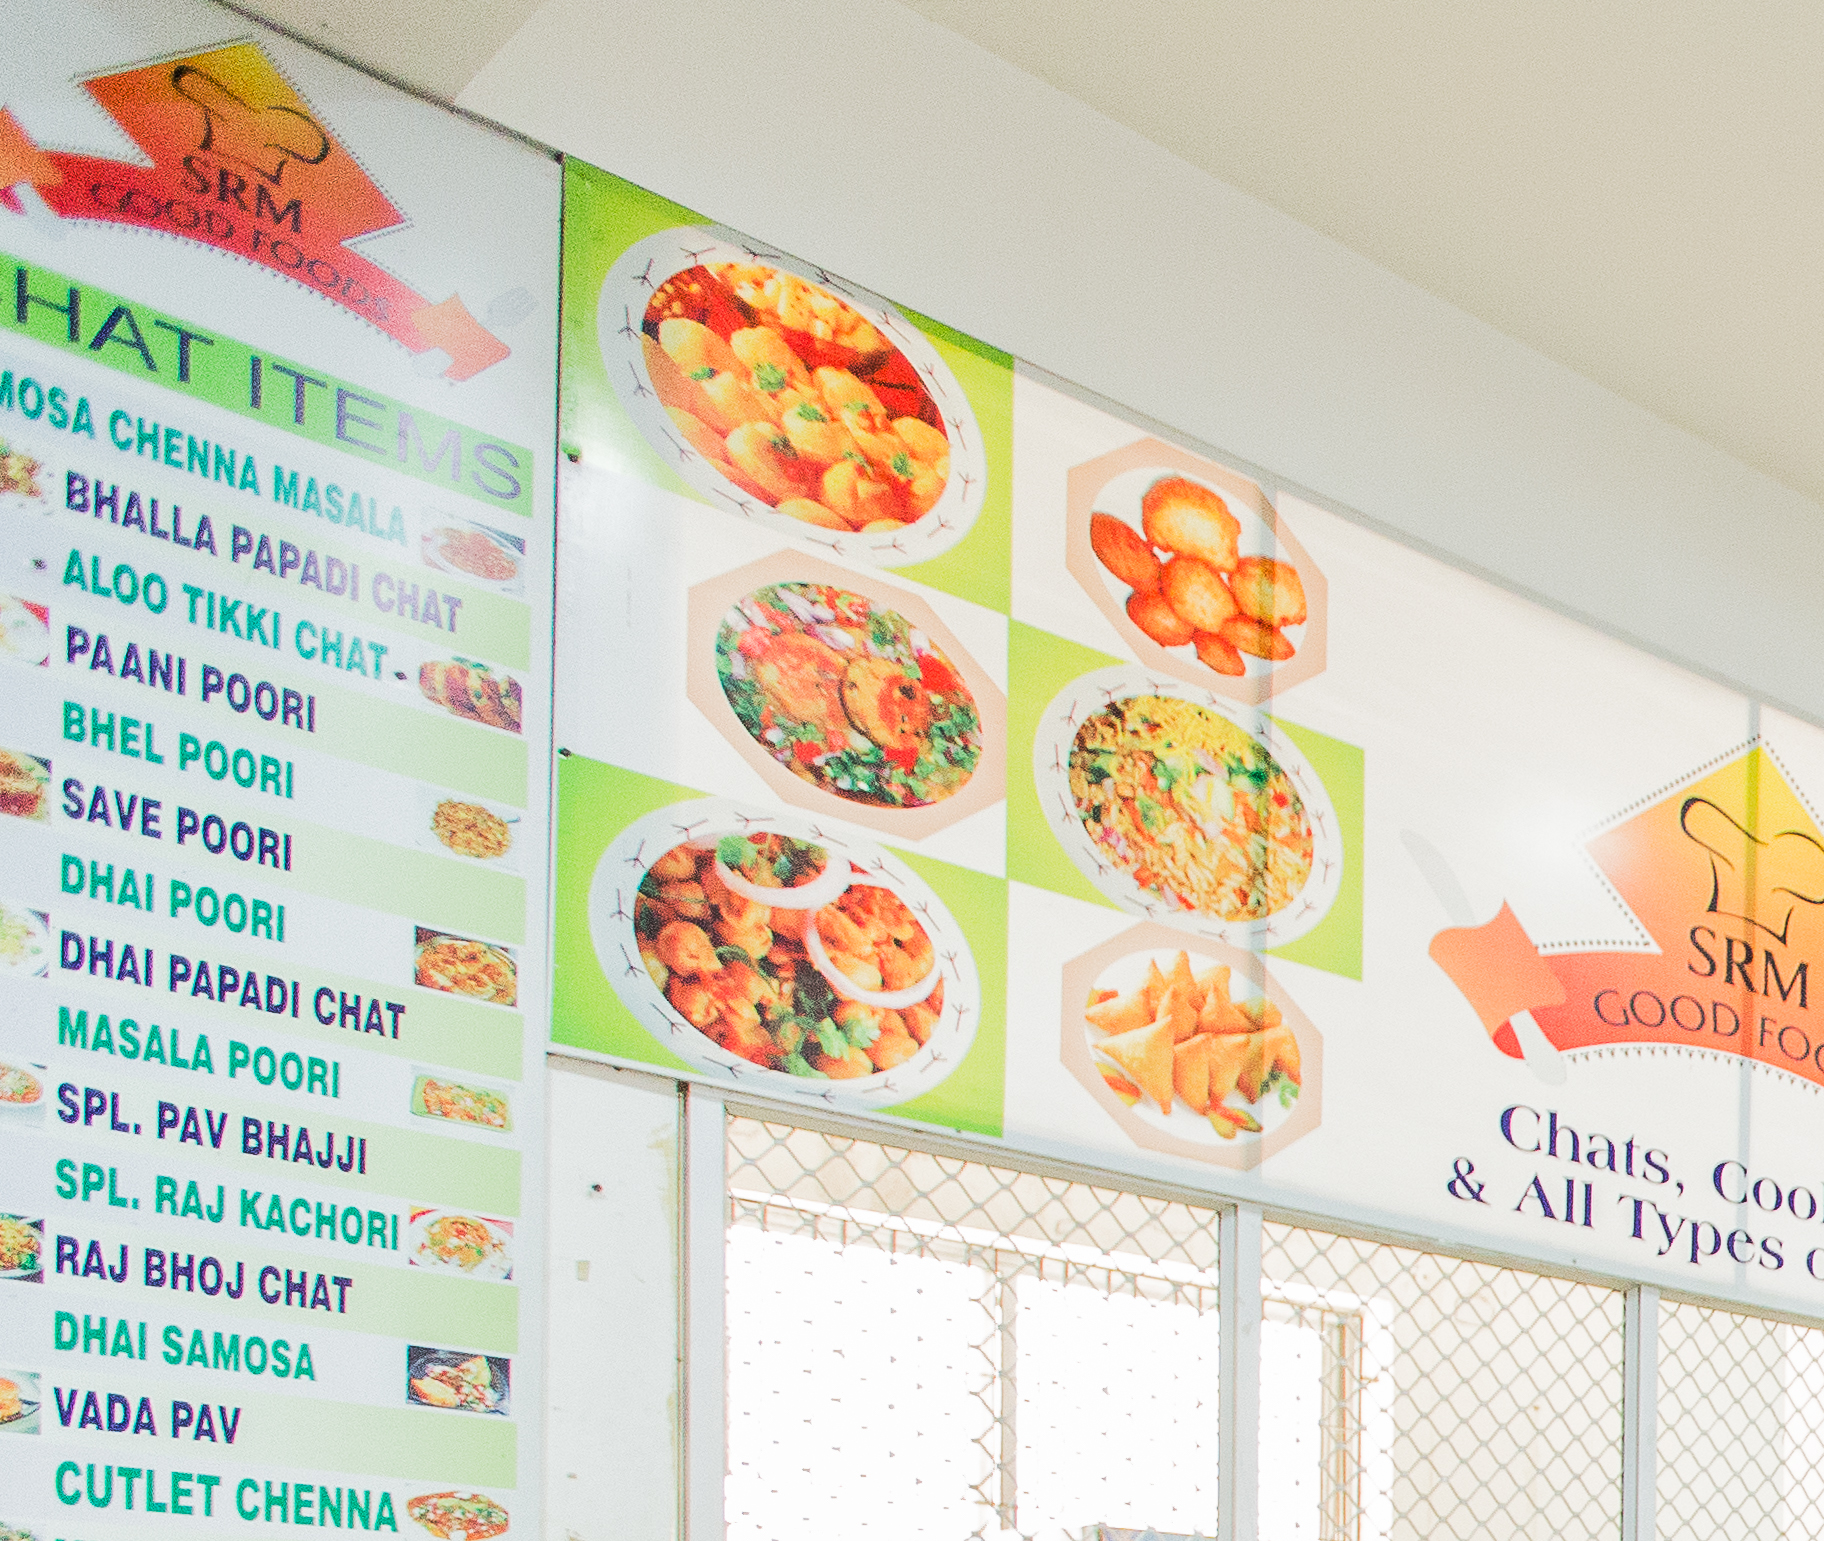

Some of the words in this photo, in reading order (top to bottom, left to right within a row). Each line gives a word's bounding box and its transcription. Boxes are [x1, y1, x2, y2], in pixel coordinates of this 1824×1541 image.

[183, 156, 301, 233] SRM
[250, 356, 521, 502] ITEMS
[109, 409, 260, 496] CHENNA
[273, 465, 407, 546] MASALA
[65, 470, 218, 557] BHALLA
[232, 524, 359, 602] PAPADI
[372, 573, 463, 634] CHAT
[63, 549, 167, 614] ALOO
[182, 584, 281, 650] TIKKI
[294, 620, 390, 680] CHAT
[66, 625, 187, 696] PAANI
[201, 664, 316, 733] POORI
[63, 700, 164, 765] BHEL
[179, 732, 295, 799] POORI
[62, 778, 163, 840] SAVE
[177, 807, 293, 872] POORI
[61, 853, 154, 912] DHAI
[170, 880, 285, 943] POORI
[60, 930, 154, 988] DHAI
[169, 954, 300, 1020] PAPADI
[313, 988, 406, 1040] CHAT
[1593, 988, 1742, 1039] GOOD
[1687, 925, 1809, 1010] SRM
[58, 1006, 215, 1075] MASALA
[228, 1040, 341, 1098] POORI
[57, 1083, 142, 1136] SPL.
[157, 1101, 228, 1149] PAV
[242, 1116, 367, 1174] BHAJJI
[1499, 1103, 1687, 1197] Chats,
[55, 1158, 140, 1210] SPL.
[155, 1174, 226, 1225] RAJ
[240, 1188, 400, 1250] KACHORI
[1446, 1155, 1492, 1207] &
[1513, 1174, 1595, 1229] All
[1617, 1193, 1785, 1272] Types
[56, 1234, 129, 1284] RAJ
[144, 1248, 245, 1299] BHOJ
[258, 1265, 353, 1314] CHAT
[54, 1310, 147, 1361] DHAI
[162, 1325, 316, 1381] SAMOSA
[53, 1386, 157, 1436] VADA
[171, 1401, 242, 1444] PAV
[55, 1460, 221, 1516] CUTLET
[236, 1478, 399, 1533] CHENNA
